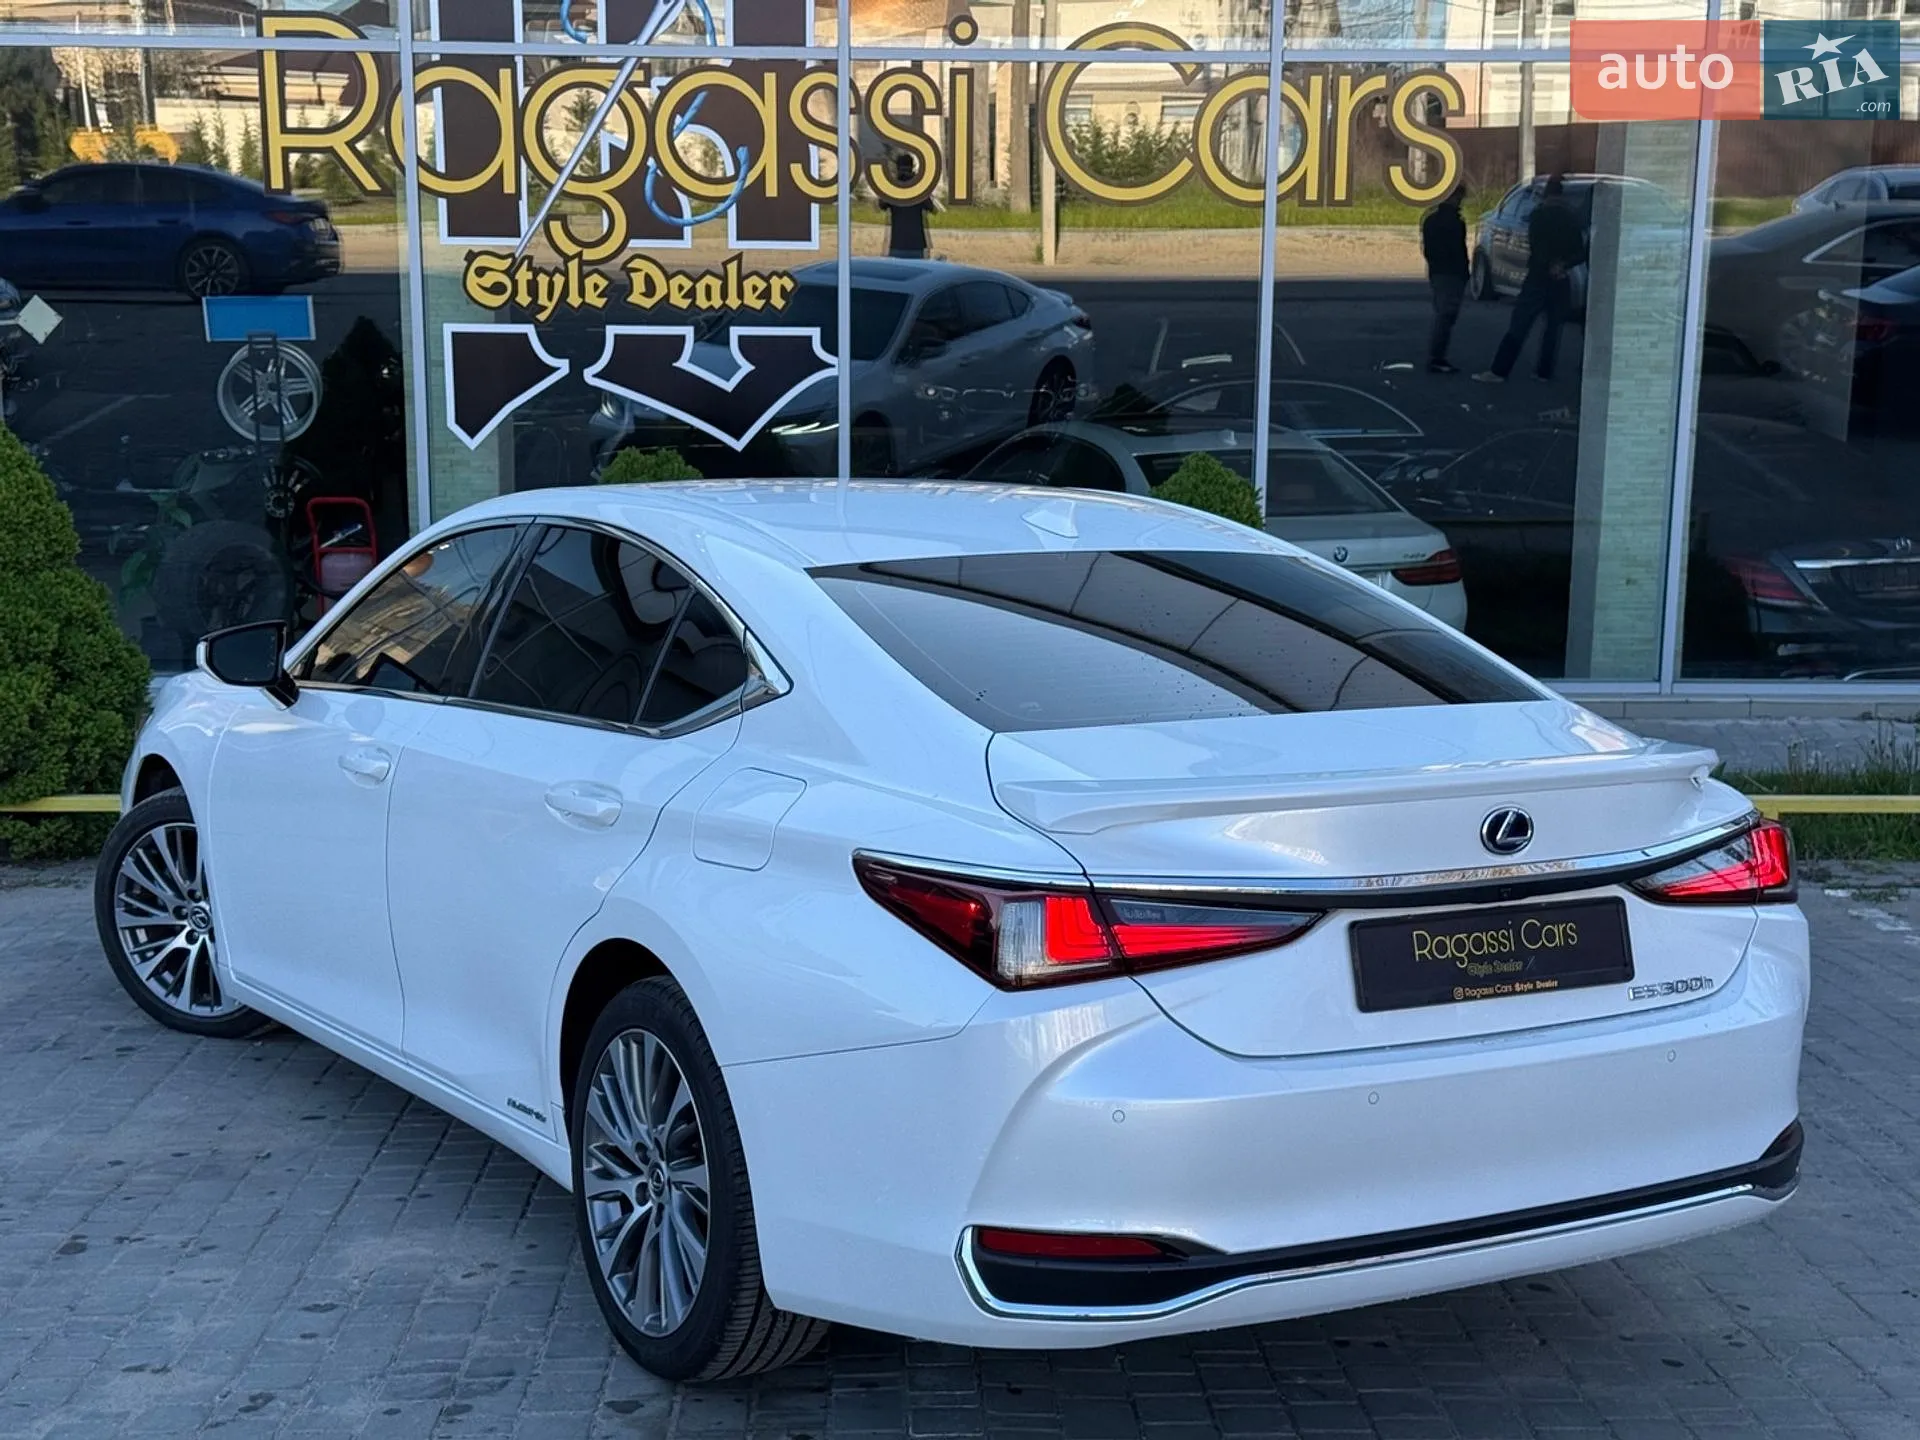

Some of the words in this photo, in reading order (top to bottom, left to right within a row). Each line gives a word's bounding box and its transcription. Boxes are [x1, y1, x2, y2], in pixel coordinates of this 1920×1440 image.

[258, 11, 976, 263] Ragassi
[1041, 20, 1465, 206] Cars
[464, 250, 612, 323] Style
[621, 251, 798, 313] Dealer
[1412, 920, 1516, 969] Ragassi
[1520, 918, 1579, 950] Cars
